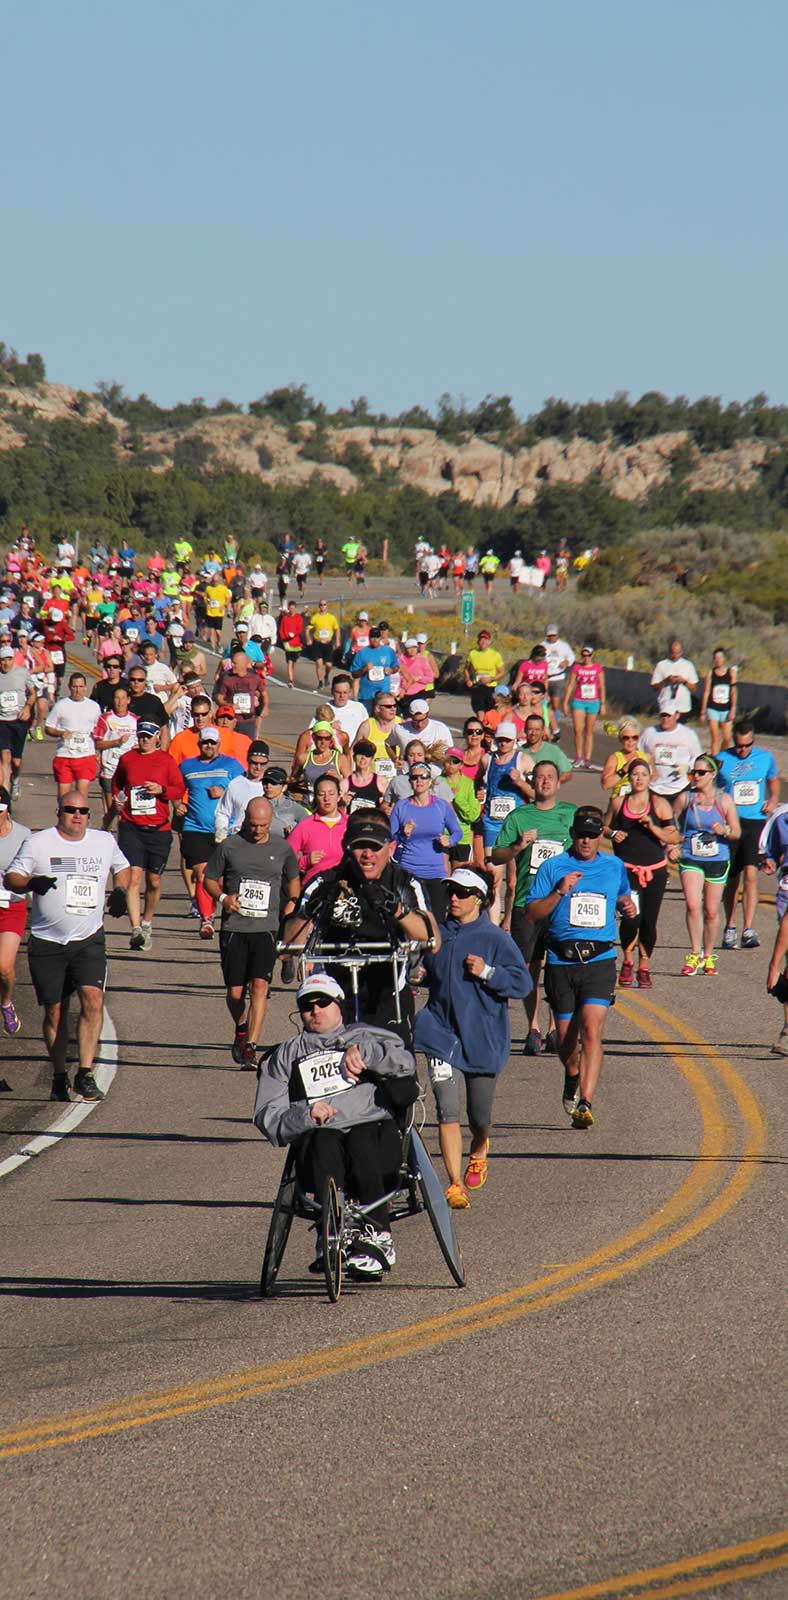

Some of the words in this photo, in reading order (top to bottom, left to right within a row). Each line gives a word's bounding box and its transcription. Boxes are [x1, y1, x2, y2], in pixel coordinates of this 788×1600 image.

[77, 857, 102, 865] TEAM
[82, 864, 100, 872] UHP
[73, 885, 92, 897] 4021
[244, 888, 264, 901] 2845
[577, 903, 599, 915] 2456
[310, 1061, 341, 1082] 2425
